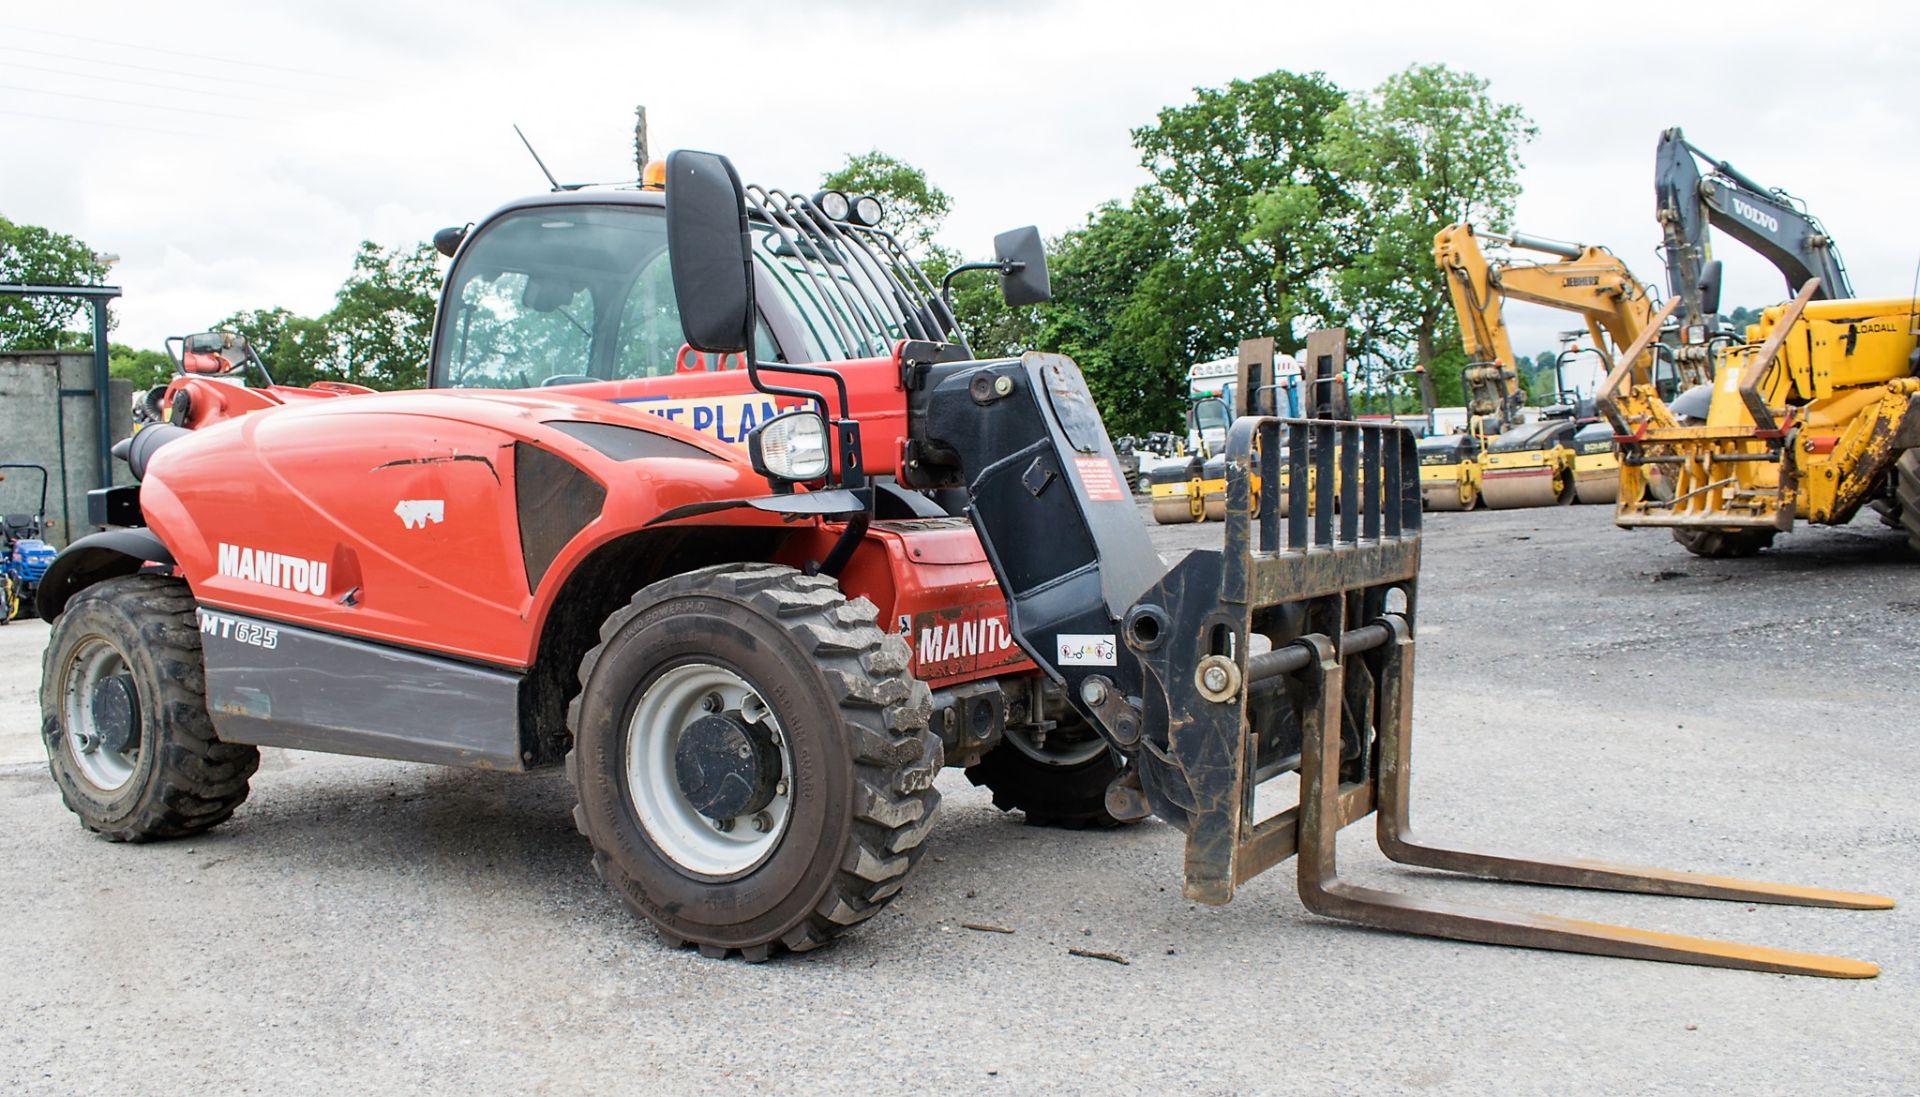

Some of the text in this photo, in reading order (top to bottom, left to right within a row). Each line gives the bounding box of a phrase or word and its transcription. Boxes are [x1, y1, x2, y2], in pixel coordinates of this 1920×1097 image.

[1732, 198, 1778, 232] VOLVO
[218, 542, 328, 596] MANITOU
[646, 603, 682, 619] POWER
[920, 618, 1018, 665] MANITO
